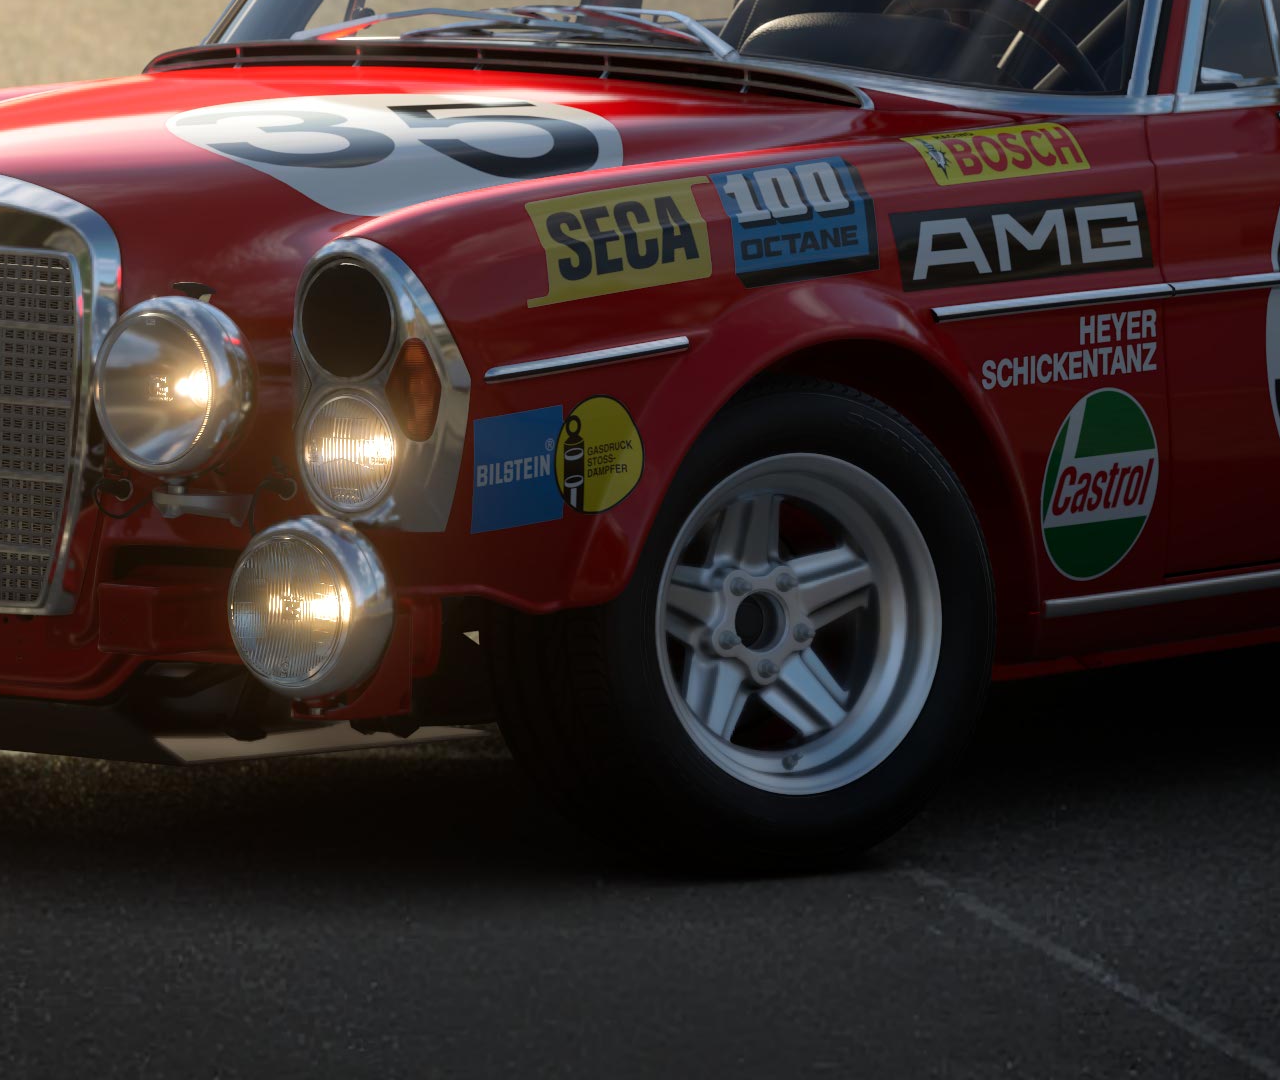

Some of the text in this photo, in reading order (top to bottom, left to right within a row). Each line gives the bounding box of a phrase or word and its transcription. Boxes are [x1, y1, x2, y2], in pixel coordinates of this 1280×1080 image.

[174, 101, 600, 179] 35
[941, 126, 1083, 176] BOSCH
[723, 161, 852, 226] 100
[546, 195, 700, 281] SECA
[740, 224, 859, 261] OCTANE
[912, 201, 1143, 281] AMG
[1079, 308, 1158, 346] HEYER
[981, 341, 1158, 391] SCHICKENTANZ
[476, 453, 551, 488] BILSTEIN
[587, 439, 633, 456] GASDRUCK
[1052, 457, 1155, 516] Castrol
